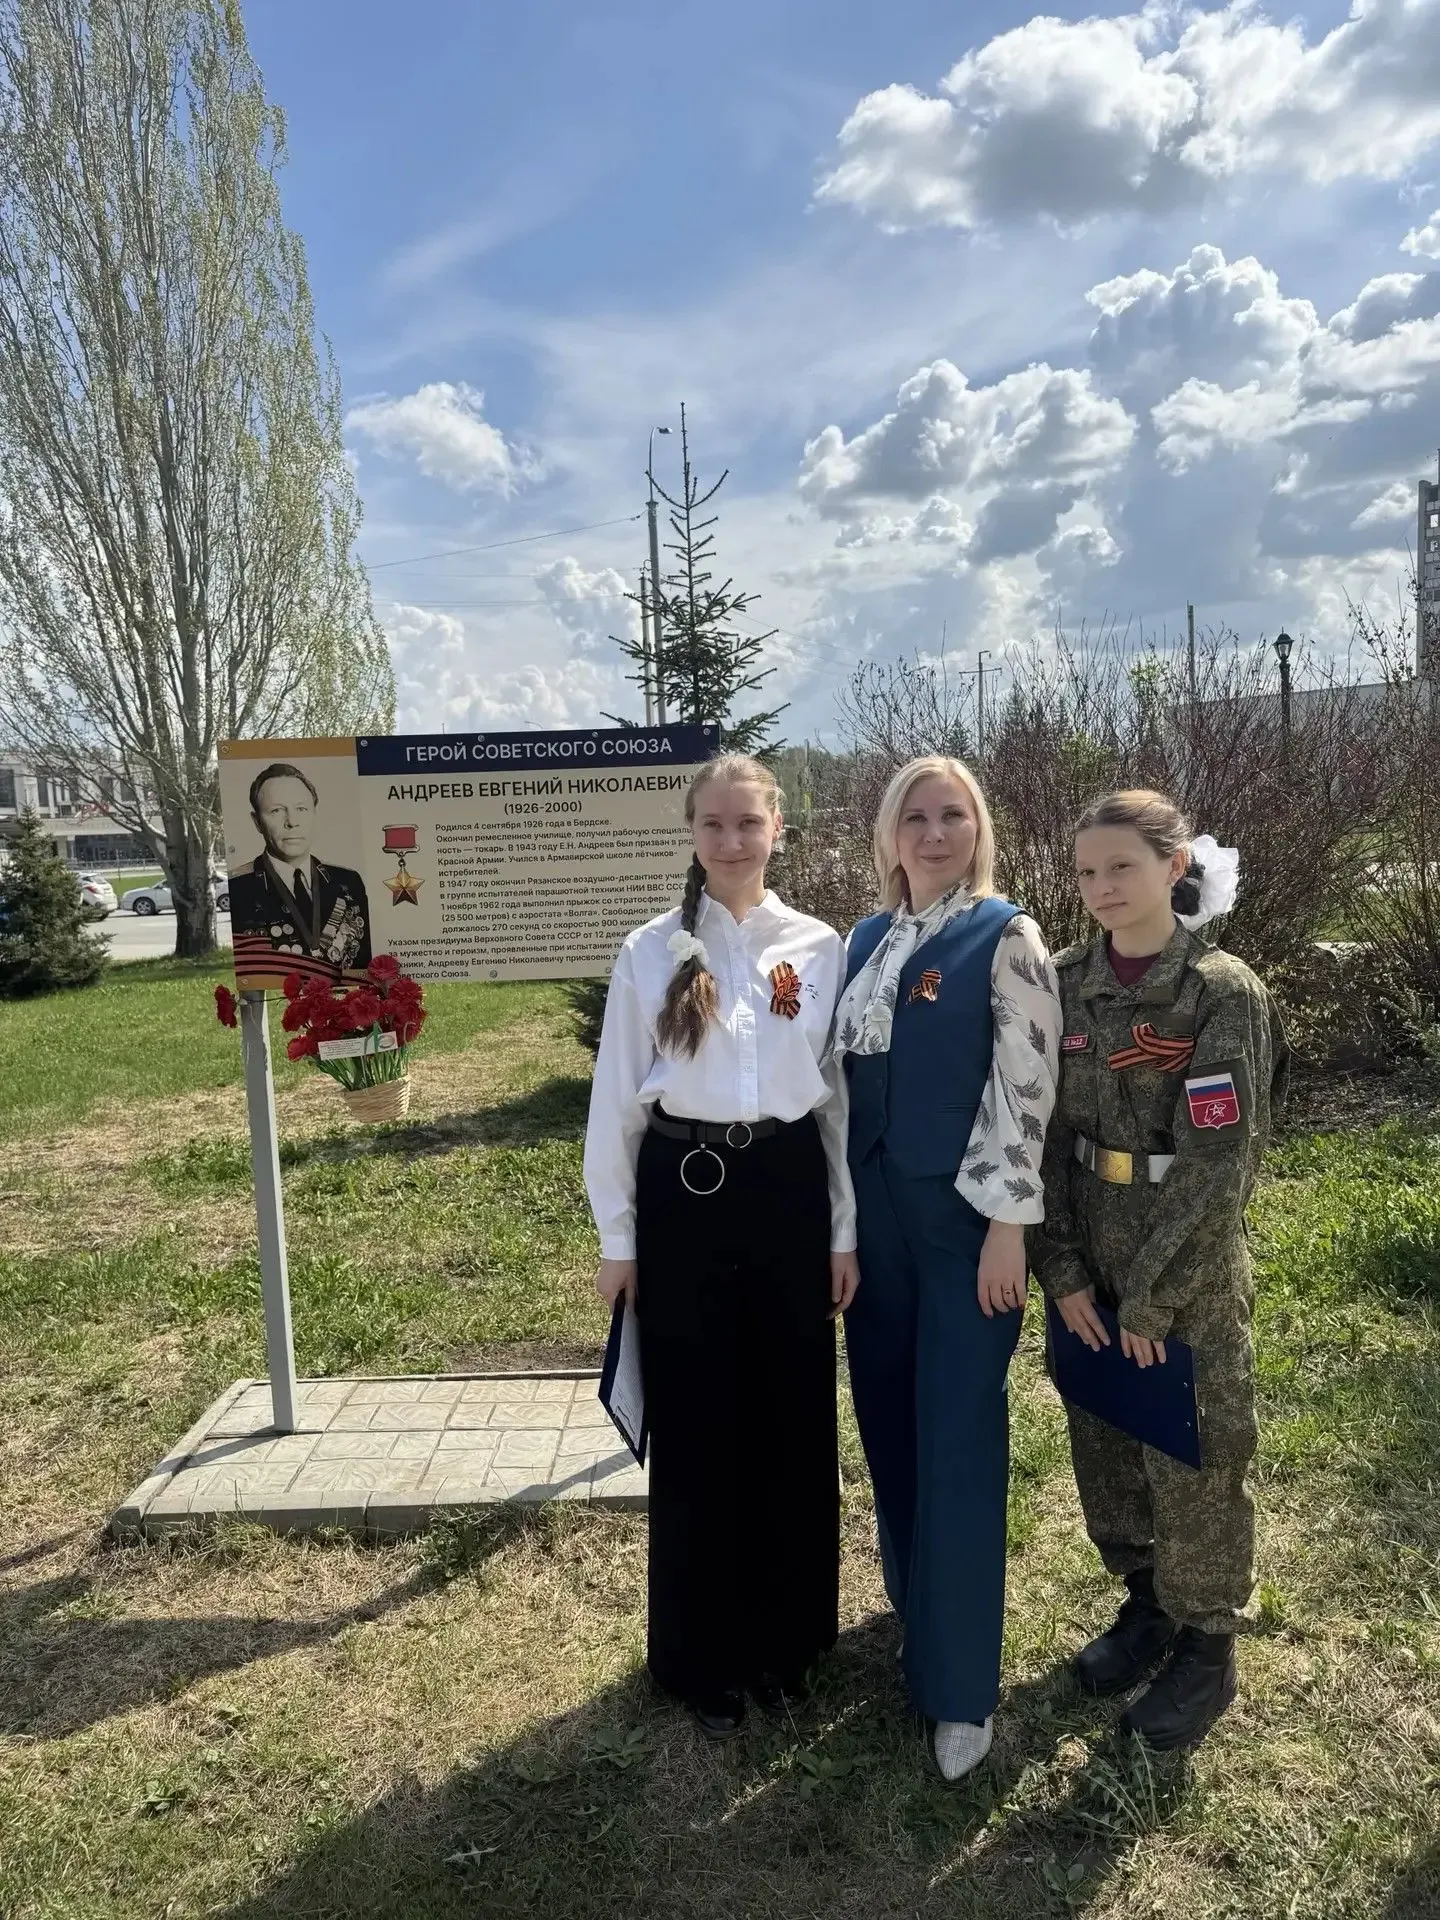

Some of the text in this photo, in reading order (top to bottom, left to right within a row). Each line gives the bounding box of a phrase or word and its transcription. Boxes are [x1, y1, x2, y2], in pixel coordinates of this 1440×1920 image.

[406, 738, 672, 762] ГЕРОЙ СОВЕТСКОГО СОЮЗА
[388, 783, 474, 802] АНДРЕЕВ
[478, 776, 562, 797] ЕВГЕНИЙ
[504, 801, 582, 816] (1926-2000)
[436, 823, 472, 832] Родился
[474, 821, 479, 829] 4
[481, 820, 521, 830] сентября
[523, 819, 543, 828] 1926
[545, 820, 565, 828] года
[574, 818, 612, 828] Бердске.
[436, 834, 473, 842] Окончил
[475, 833, 532, 843] ремесленное
[534, 831, 574, 841] училище,
[576, 830, 611, 839] получил
[612, 828, 649, 838] рабочую
[475, 845, 506, 854] токарь.
[508, 843, 513, 851] В
[516, 842, 536, 851] 1943
[538, 843, 557, 852] году
[560, 841, 576, 849] Е.Н.
[578, 841, 614, 850] Андреев
[616, 839, 633, 847] был
[635, 839, 669, 849] призван
[678, 838, 694, 847] ряд
[438, 856, 474, 867] Красной
[476, 856, 506, 866] Армии.
[509, 854, 538, 862] Учился
[547, 851, 605, 863] Армавирской
[635, 850, 677, 858] лётчиков-
[438, 867, 500, 878] истребителей.
[440, 880, 444, 888] В
[448, 879, 467, 887] 1947
[469, 880, 488, 888] году
[528, 877, 571, 885] Рязанское
[573, 874, 663, 884] воздушно-десантное
[665, 873, 685, 882] учил
[447, 892, 476, 901] группе
[478, 888, 533, 898] испытателей
[535, 886, 588, 897] парашютной
[626, 883, 645, 892] НИИ
[647, 883, 664, 891] ВВС
[441, 902, 445, 910] 1
[447, 901, 477, 911] ноября
[479, 900, 500, 909] 1962
[501, 901, 520, 909] года
[566, 898, 601, 908] прыжок
[614, 895, 671, 906] стратосферы
[442, 913, 456, 923] (25
[457, 912, 474, 921] 500
[476, 911, 510, 922] метров)
[519, 911, 561, 920] аэростата
[564, 908, 600, 917] «Волга».
[602, 907, 648, 916] Свободное
[442, 925, 490, 934] должалось
[492, 922, 508, 931] 270
[510, 923, 540, 932] секунд
[554, 920, 599, 930] скоростью
[601, 918, 618, 926] 900
[388, 938, 419, 946] Указом
[420, 937, 472, 947] президиума
[474, 935, 523, 945] Верховного
[525, 933, 555, 941] Совета
[557, 931, 581, 940] СССР
[594, 930, 604, 938] 12
[400, 949, 442, 959] мужество
[451, 947, 489, 957] героизм,
[491, 945, 547, 955] проявленные
[549, 945, 565, 953] при
[566, 943, 612, 951] испытании
[428, 959, 470, 968] Андрееву
[472, 957, 507, 965] Евгению
[509, 955, 564, 964] Николаевичу
[566, 954, 611, 963] присвоено
[396, 969, 471, 979] оветского Союза.
